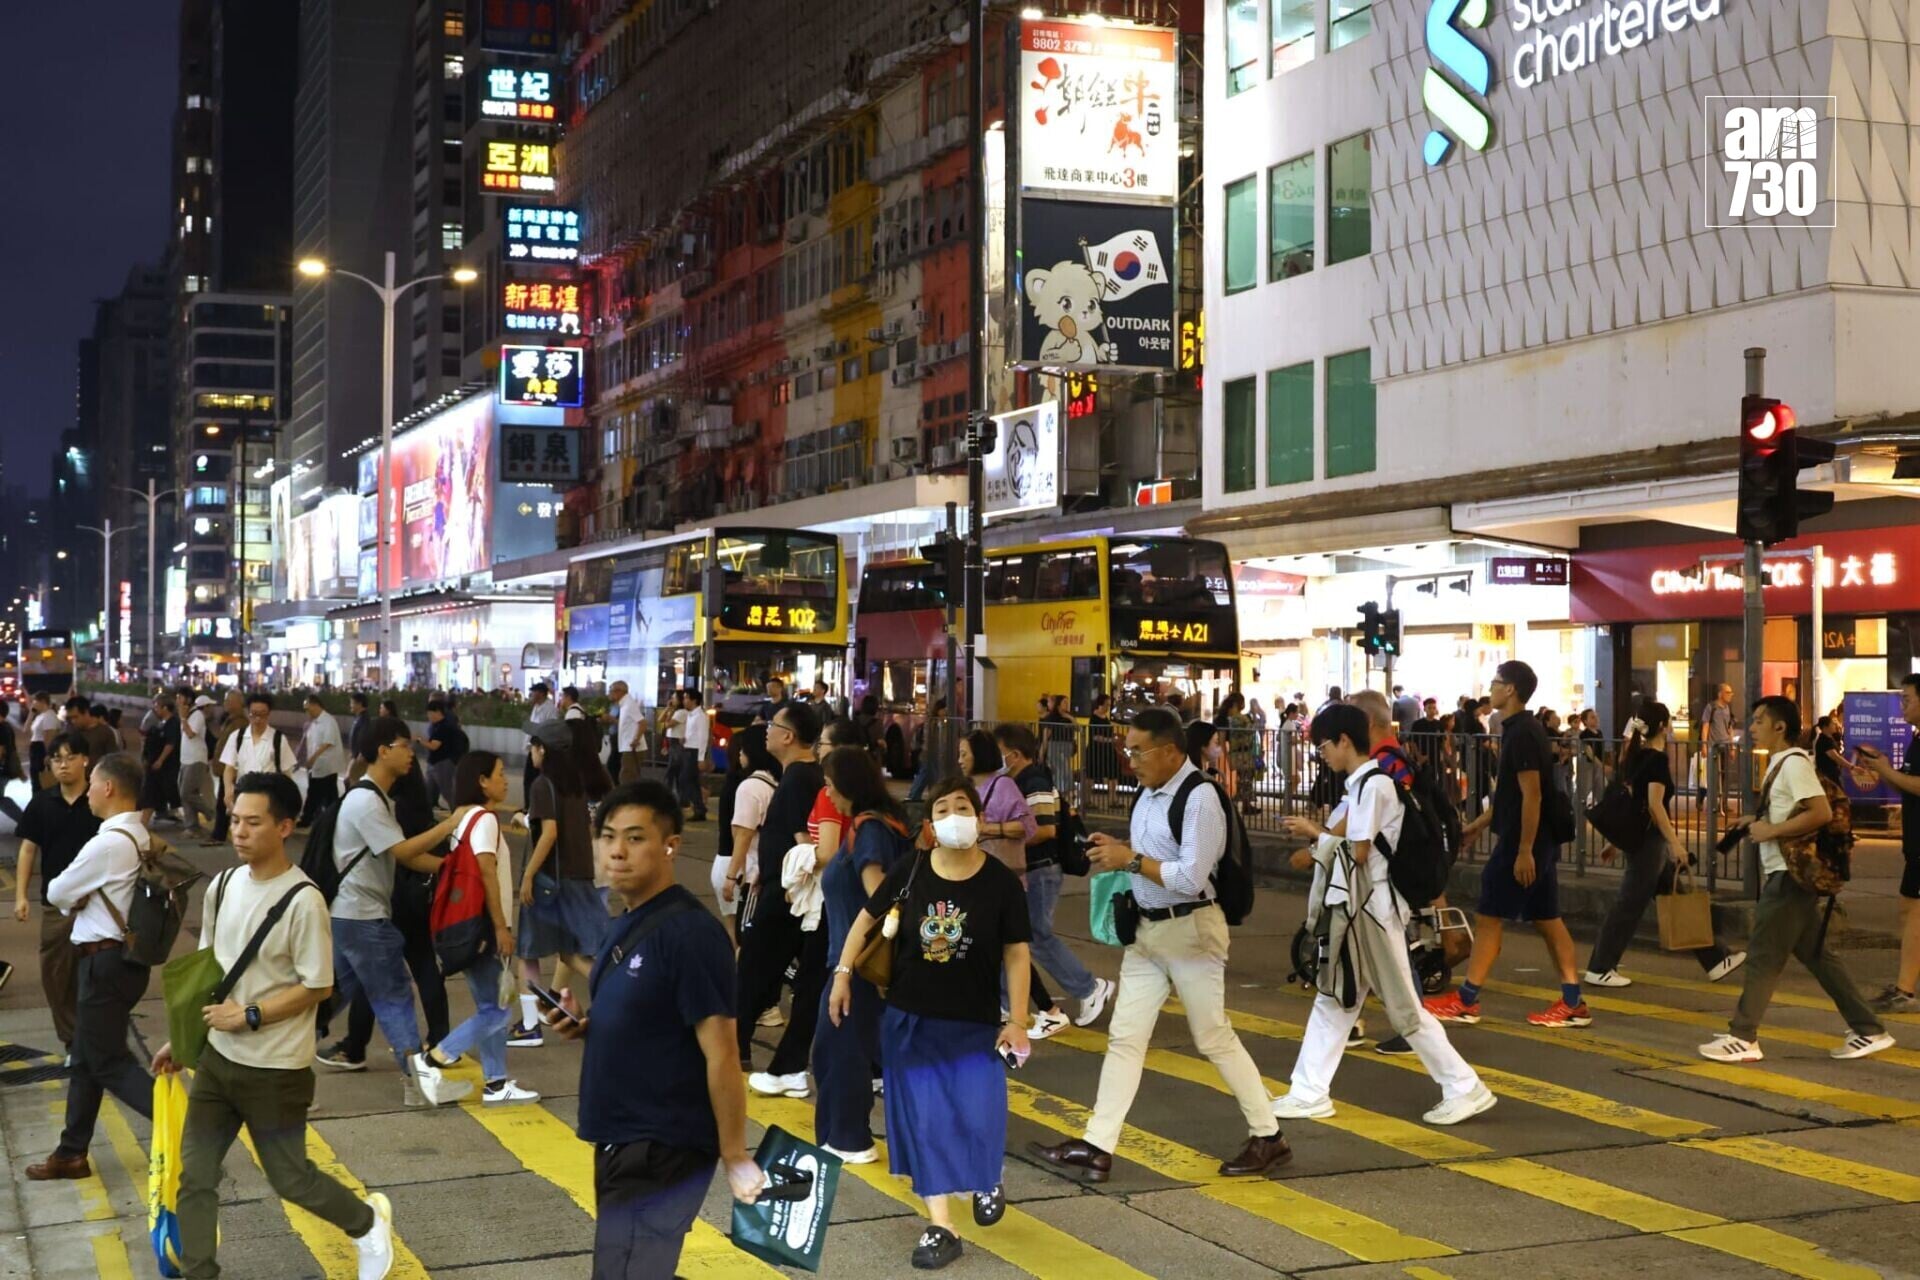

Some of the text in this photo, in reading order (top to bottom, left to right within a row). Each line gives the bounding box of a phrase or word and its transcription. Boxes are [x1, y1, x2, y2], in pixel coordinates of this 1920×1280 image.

[1033, 38, 1061, 50] 9802
[488, 69, 550, 101] 世紀
[487, 142, 549, 174] 亞洲
[505, 283, 579, 312] 新輝煌
[1106, 316, 1171, 332] OUTDARK
[788, 608, 816, 630] 102
[1139, 623, 1208, 643] Airport A21
